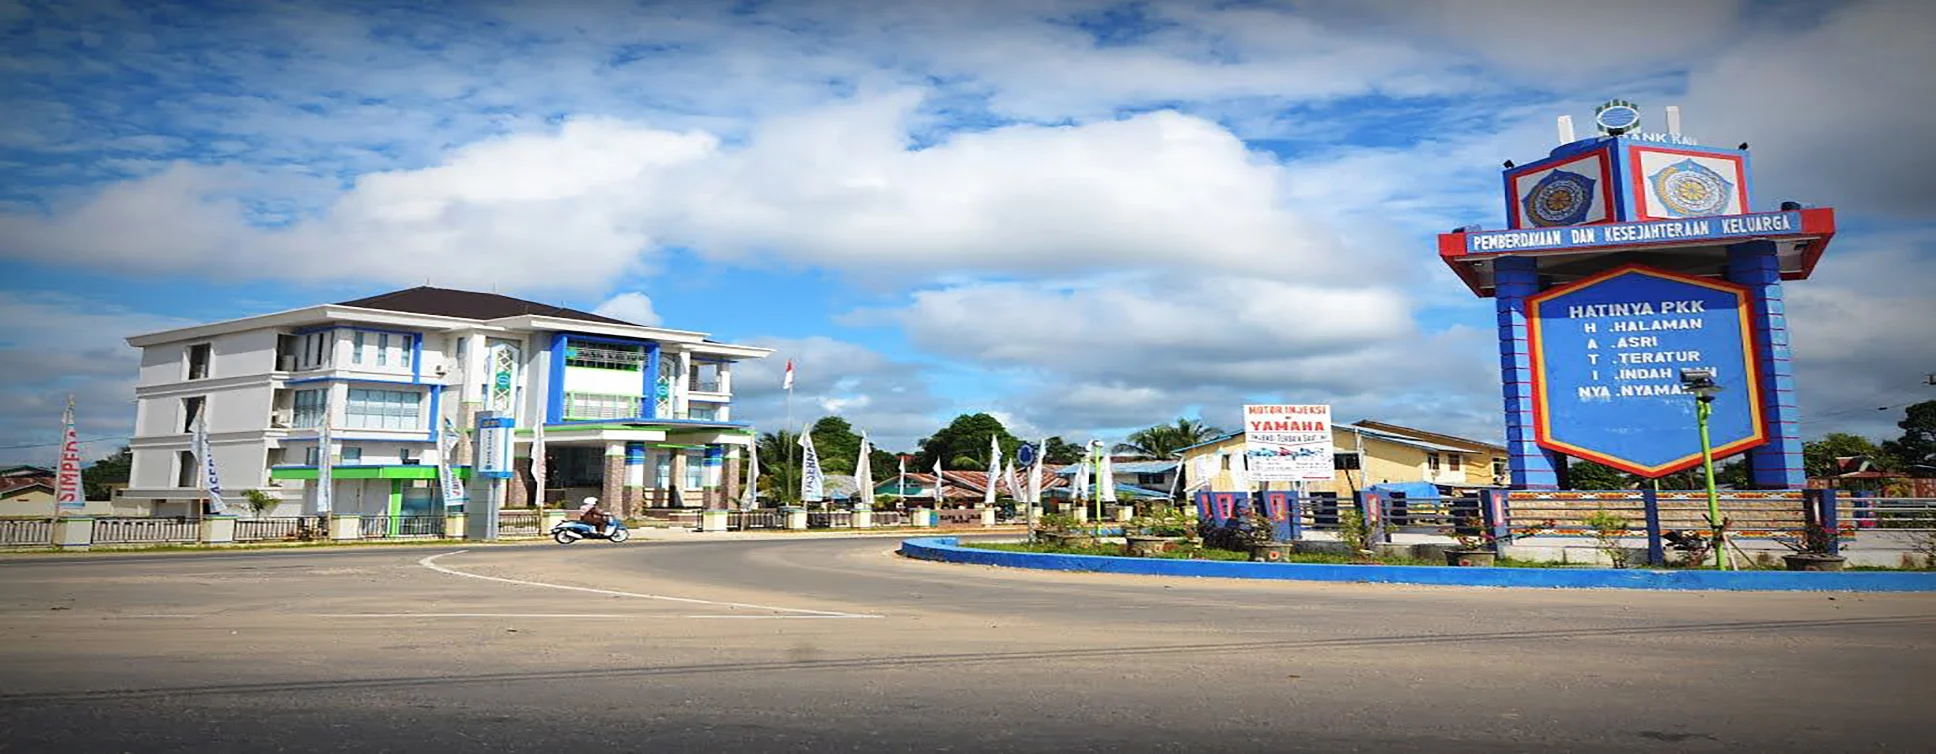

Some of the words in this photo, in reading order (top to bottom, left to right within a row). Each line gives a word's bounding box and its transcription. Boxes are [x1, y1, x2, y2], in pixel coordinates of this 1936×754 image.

[1473, 230, 1561, 250] PEMBERDAYAAN
[1571, 228, 1595, 244] DAN
[1604, 220, 1709, 242] KESEJAHTERAAN
[1721, 214, 1791, 234] KELUARGA
[1569, 302, 1655, 319] HATINYA
[1660, 300, 1705, 314] PKK
[1584, 323, 1597, 333] H
[1587, 338, 1598, 349] A
[1587, 354, 1599, 365] T
[1592, 370, 1598, 381] I
[1578, 386, 1611, 397] NYA
[1248, 406, 1283, 415] MOTOR
[1285, 406, 1326, 415] INJEKSI
[1250, 421, 1325, 431] YAMAHA
